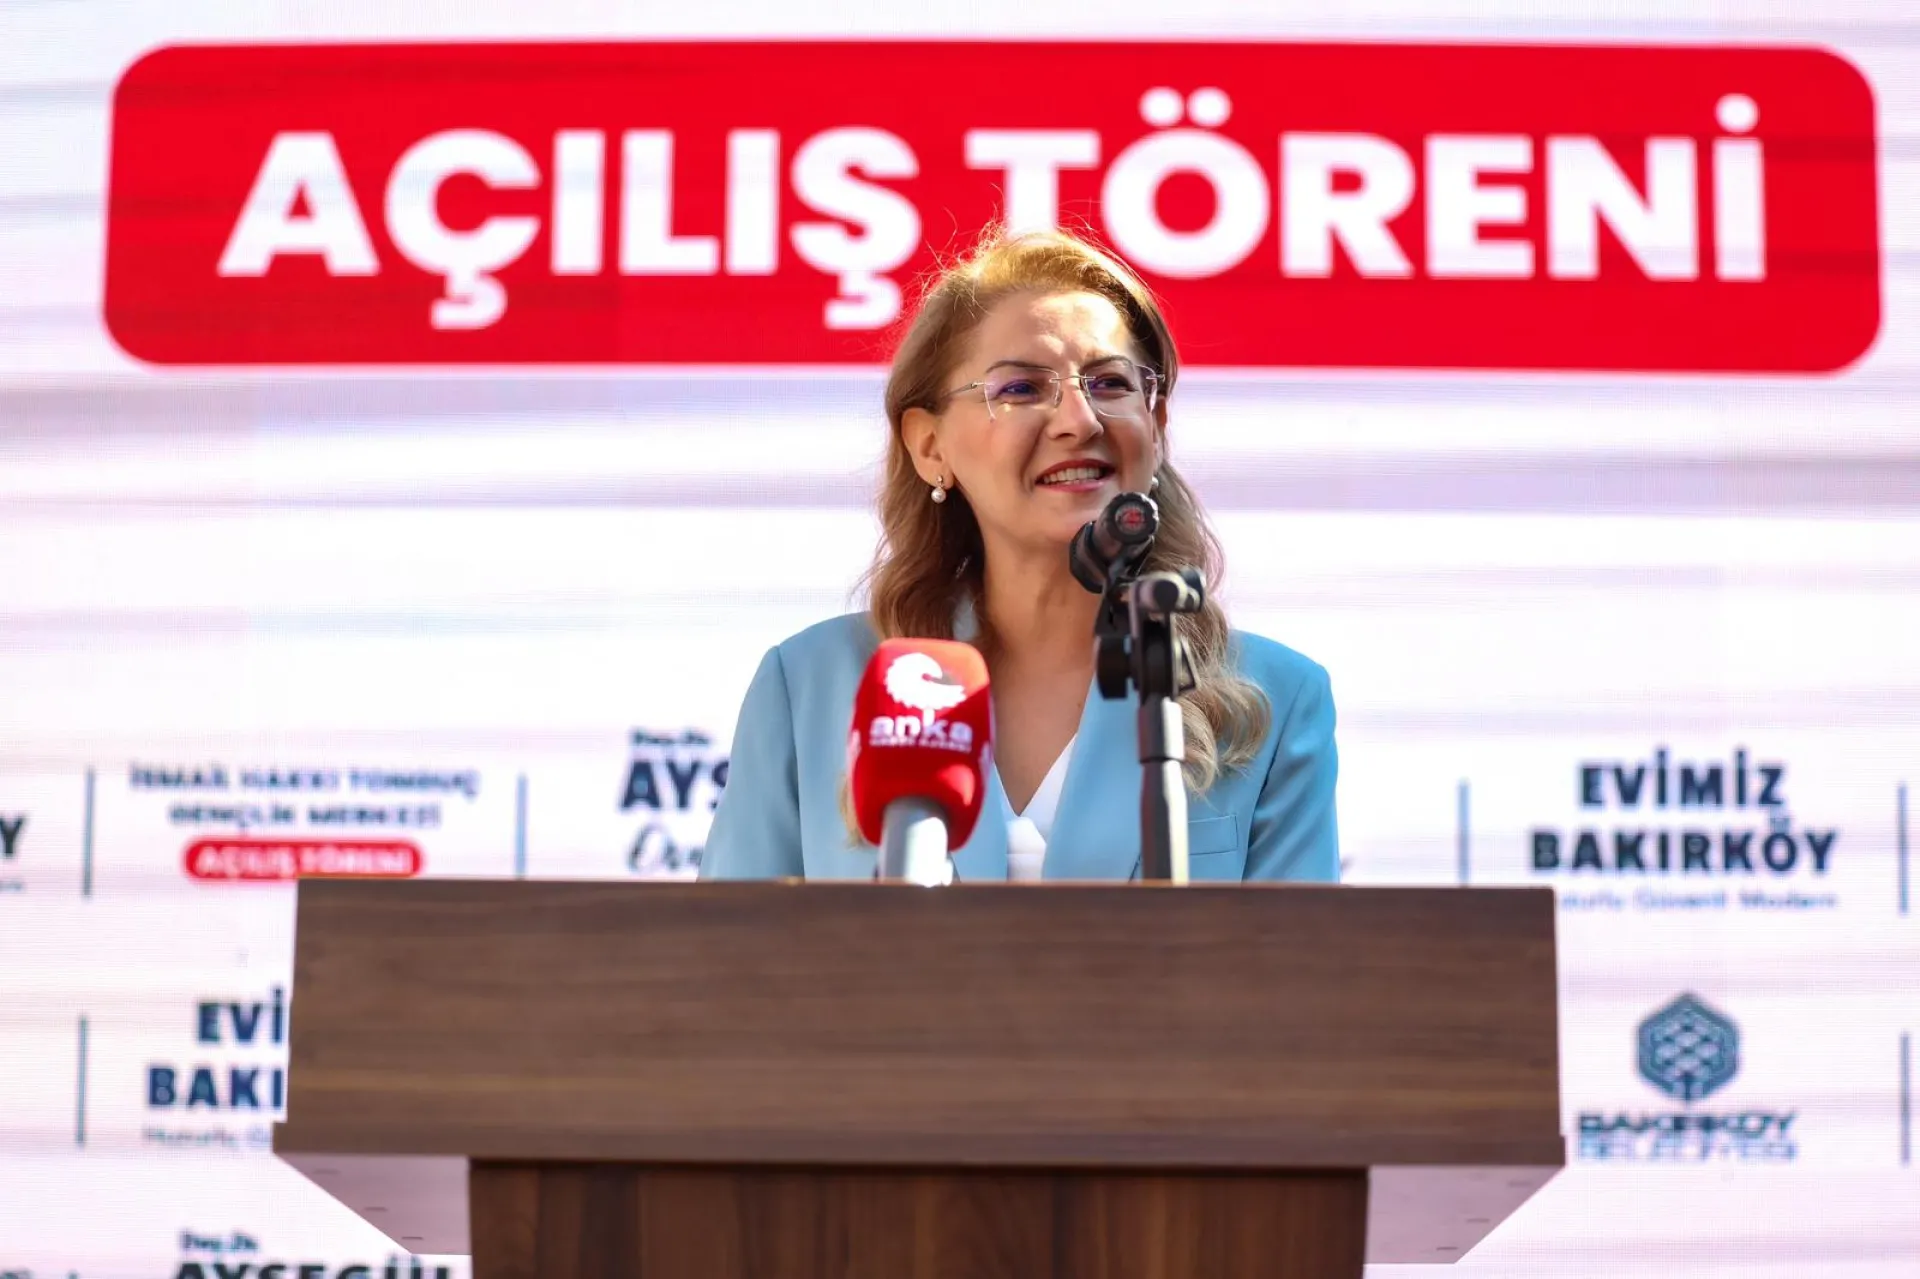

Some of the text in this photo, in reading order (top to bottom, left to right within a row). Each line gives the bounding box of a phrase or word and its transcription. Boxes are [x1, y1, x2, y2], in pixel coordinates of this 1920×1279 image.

[217, 87, 1767, 331] AÇILIŞ TÖRENİ
[870, 710, 974, 742] anka
[1579, 747, 1785, 807] EVİMİZ
[1531, 816, 1838, 873] BAKIRKÖY
